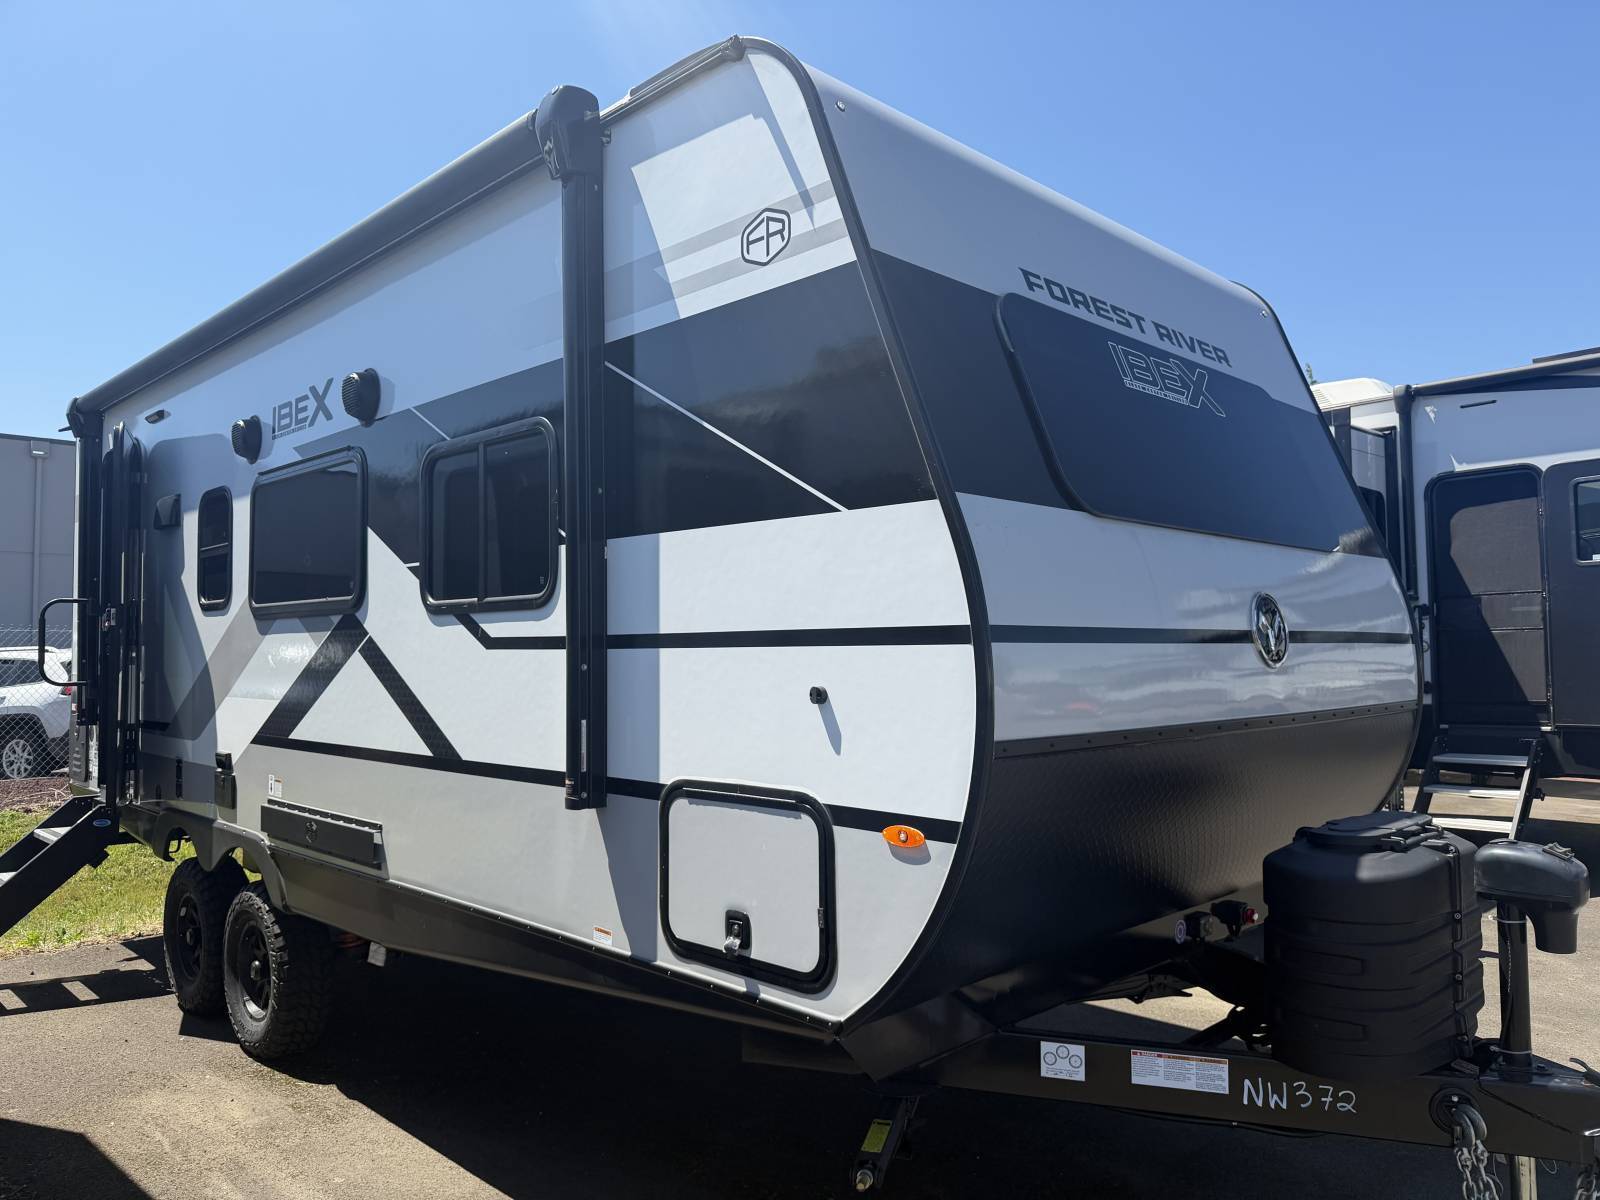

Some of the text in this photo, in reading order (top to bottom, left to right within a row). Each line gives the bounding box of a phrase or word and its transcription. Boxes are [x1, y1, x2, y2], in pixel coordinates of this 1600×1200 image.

[1017, 266, 1233, 369] FOREST RIVER
[271, 377, 335, 435] IBEX
[1107, 340, 1227, 418] IBEX
[1242, 1076, 1357, 1114] NW372
